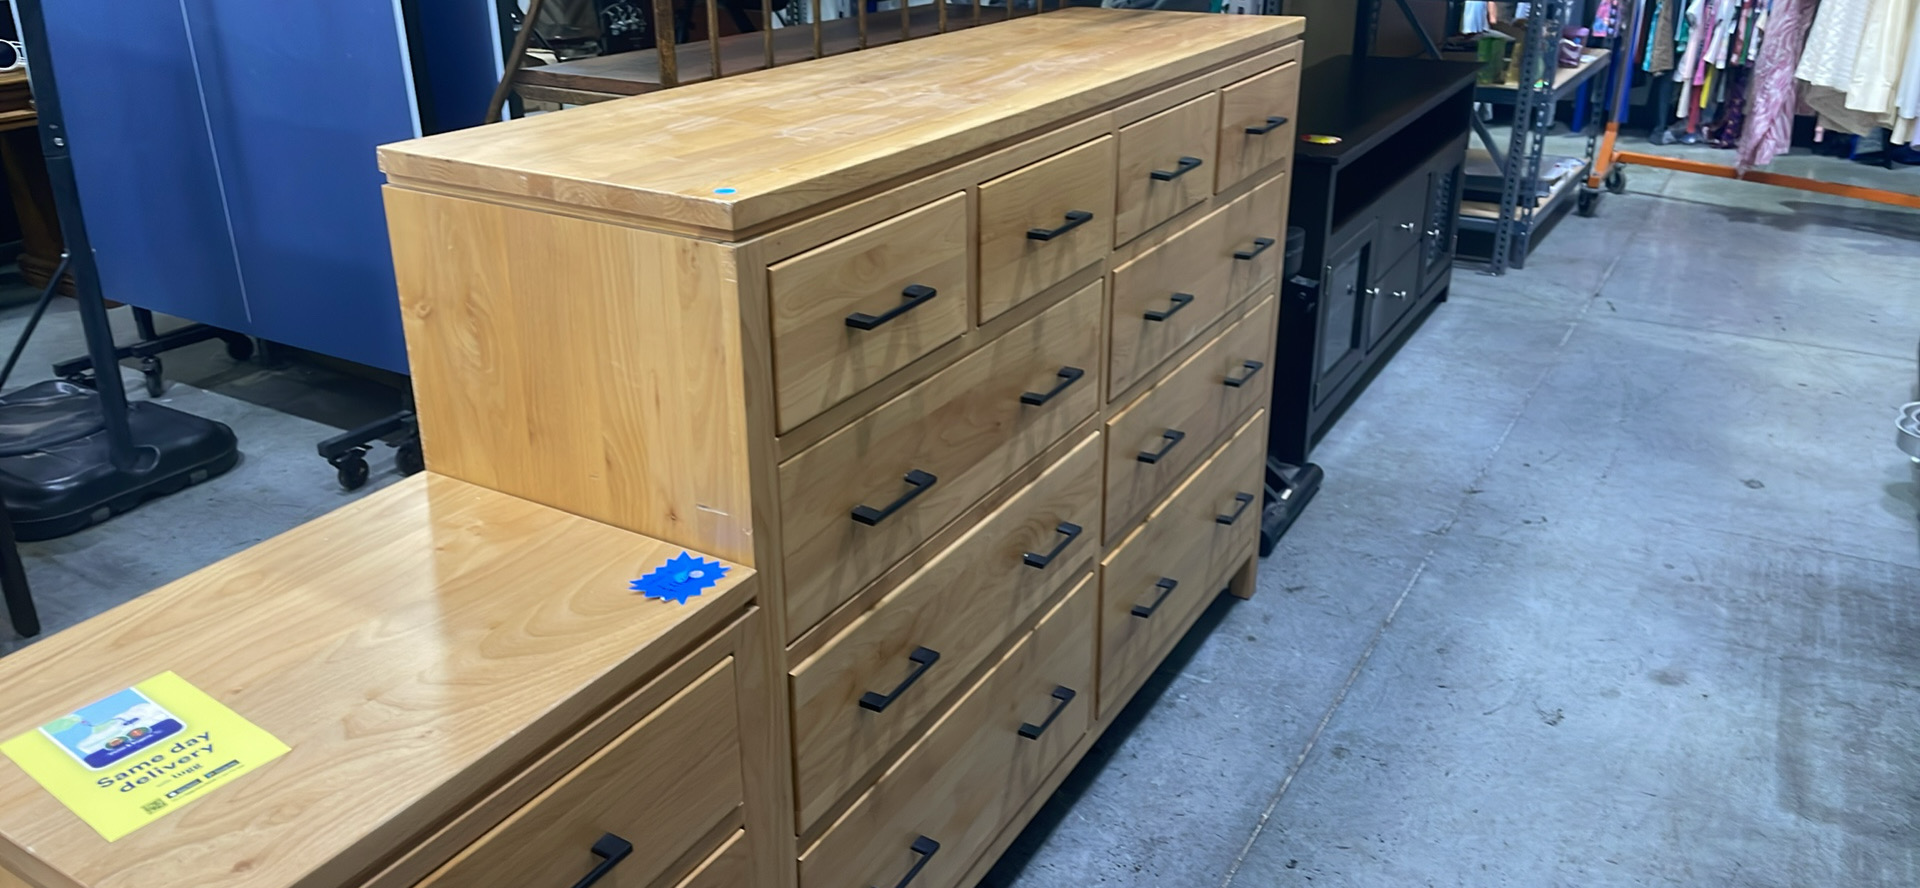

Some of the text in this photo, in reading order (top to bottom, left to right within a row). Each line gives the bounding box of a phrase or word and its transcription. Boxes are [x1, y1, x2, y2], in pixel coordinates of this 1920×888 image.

[97, 754, 165, 788] Same
[170, 731, 210, 754] day
[120, 744, 213, 793] delivery
